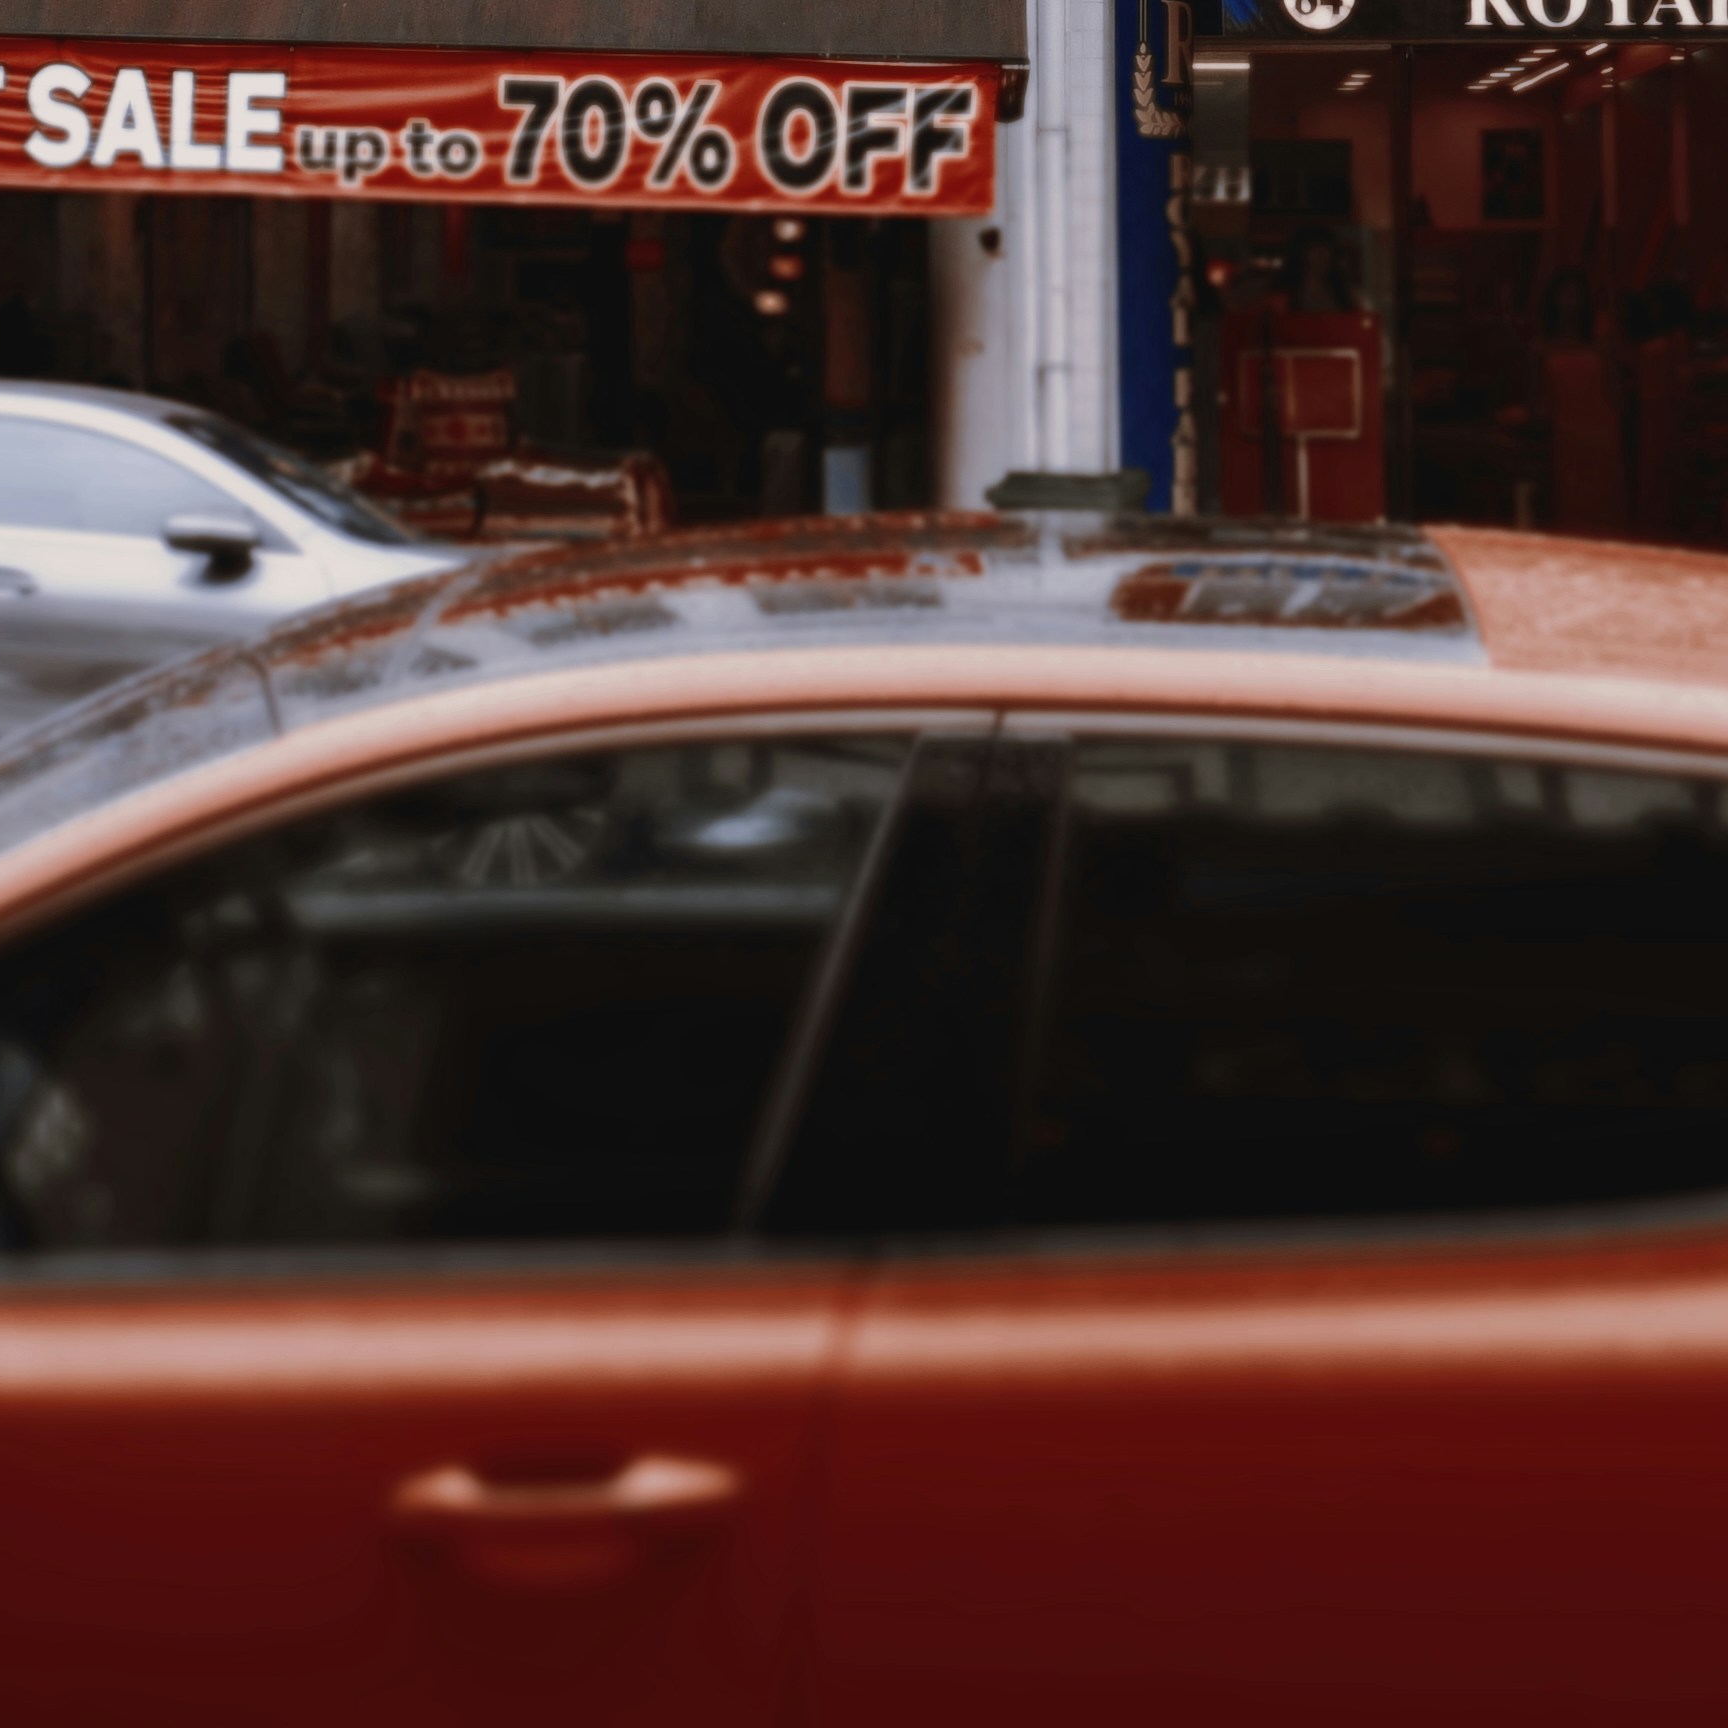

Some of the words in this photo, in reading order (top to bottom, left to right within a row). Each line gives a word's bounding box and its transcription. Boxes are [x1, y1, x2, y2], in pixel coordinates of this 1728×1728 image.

[23, 63, 287, 173] SALE
[297, 126, 387, 187] up
[406, 120, 481, 176] to
[501, 75, 734, 188] 70%
[759, 78, 977, 195] OFF
